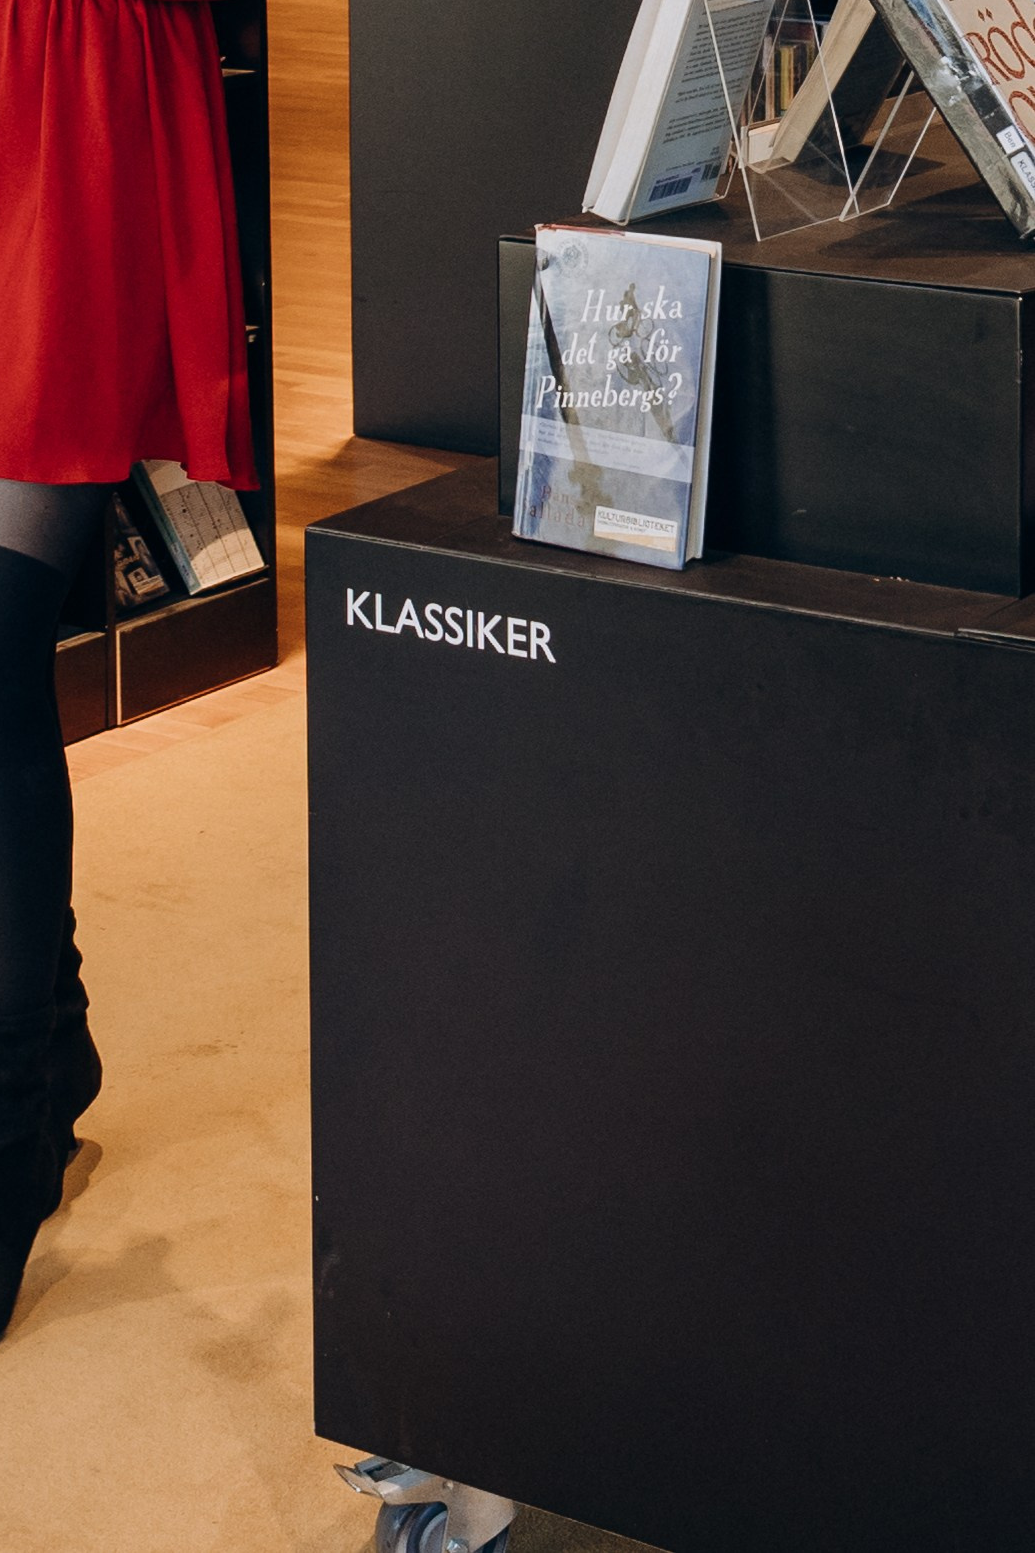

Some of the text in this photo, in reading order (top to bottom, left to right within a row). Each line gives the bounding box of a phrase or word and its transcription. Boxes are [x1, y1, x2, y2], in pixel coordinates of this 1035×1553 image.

[581, 286, 683, 323] Hur ska
[561, 328, 683, 370] det gå för
[536, 372, 683, 412] Pinnebergs?
[523, 499, 585, 527] allada
[597, 511, 675, 533] KULTURBIBLIOTEKET
[347, 588, 556, 663] KLASSIKER
